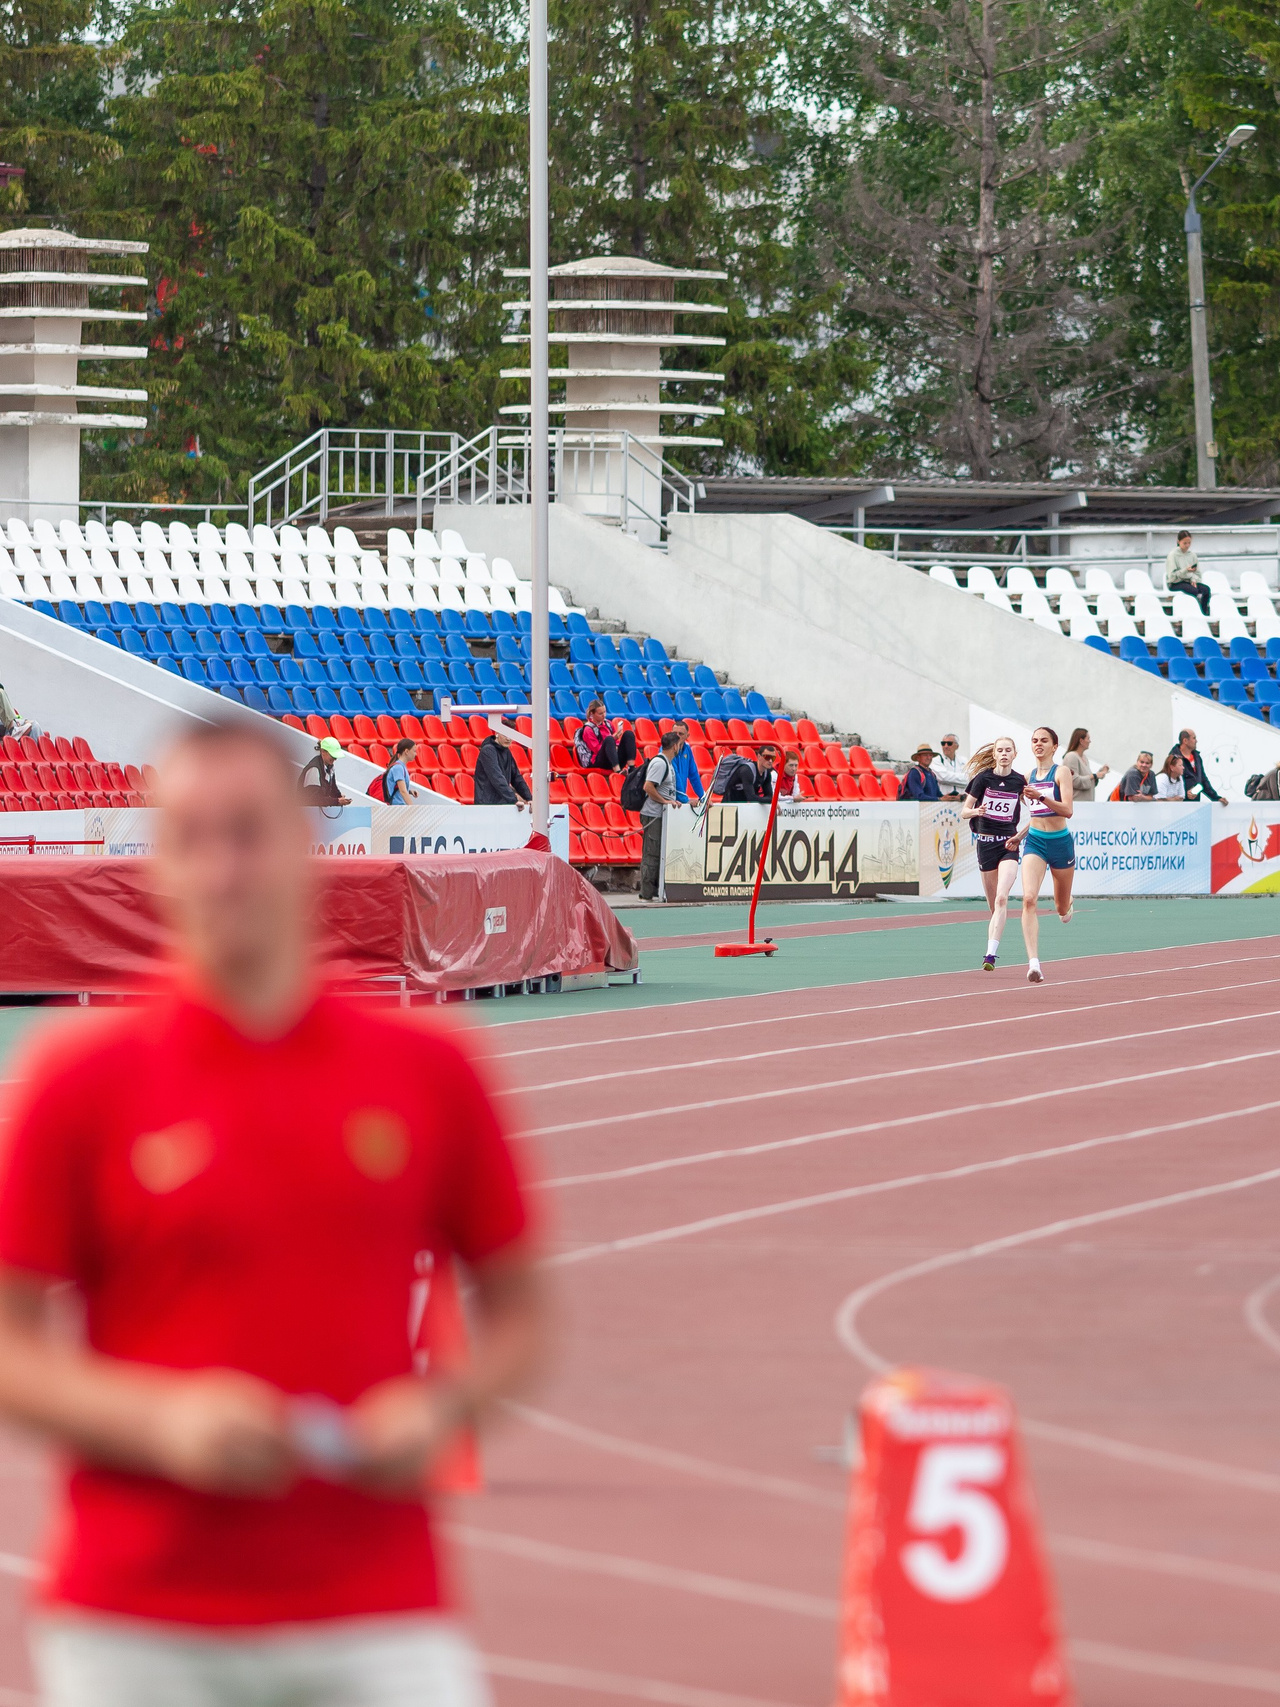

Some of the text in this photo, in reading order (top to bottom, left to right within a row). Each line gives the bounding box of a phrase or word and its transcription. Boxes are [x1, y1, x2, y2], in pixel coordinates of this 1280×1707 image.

[827, 805, 860, 821] фабрика
[987, 800, 1010, 813] 165
[1072, 827, 1198, 846] ИЗИЧЕСКОЙ КУЛЬТУРЫ
[1111, 855, 1185, 871] РЕСПУБЛИКИ
[901, 1441, 1010, 1603] 5
